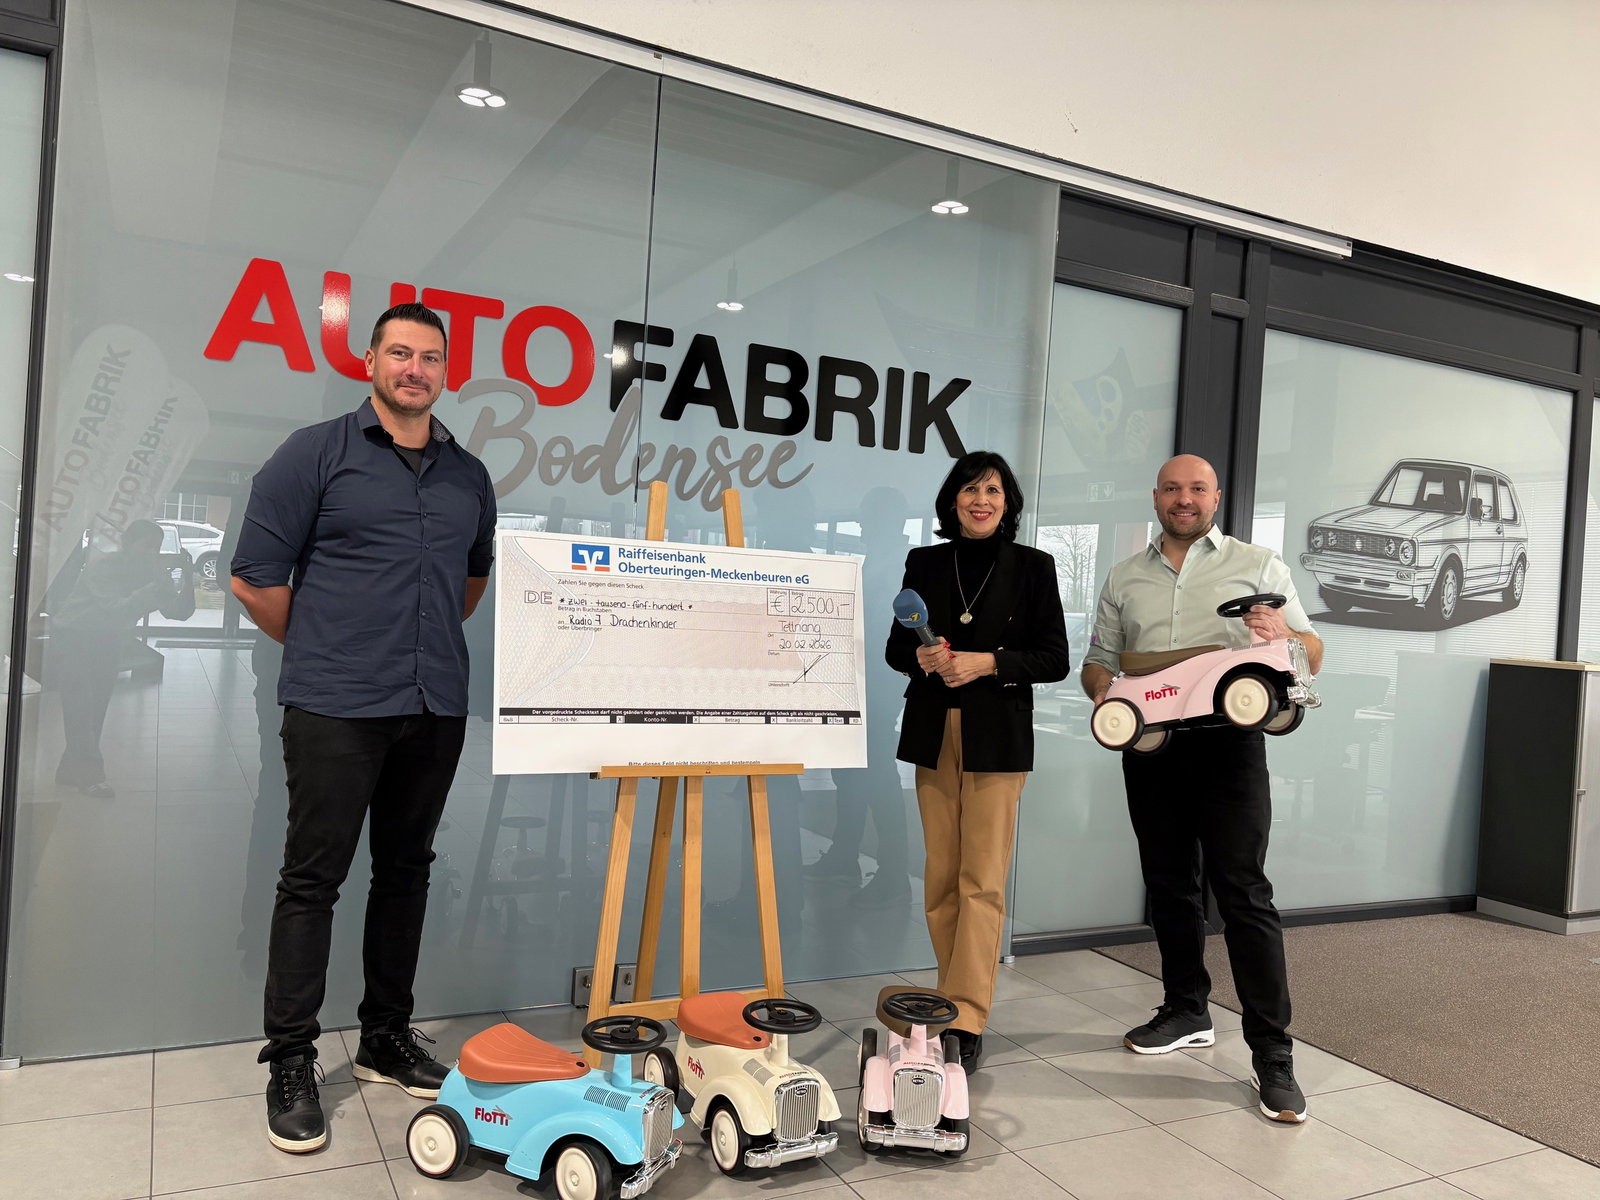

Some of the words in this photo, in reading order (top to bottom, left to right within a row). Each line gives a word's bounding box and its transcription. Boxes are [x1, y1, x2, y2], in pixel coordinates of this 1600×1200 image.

[456, 378, 815, 512] Bodensee
[618, 547, 706, 564] Raiffeisenbank
[618, 561, 792, 584] Oberteuringen-Meckenbeuren
[795, 574, 810, 585] eG
[524, 590, 552, 604] DE
[770, 595, 784, 613] €
[569, 614, 592, 626] Radio
[610, 614, 677, 629] Drachenkinder
[778, 620, 822, 642] Tettnang
